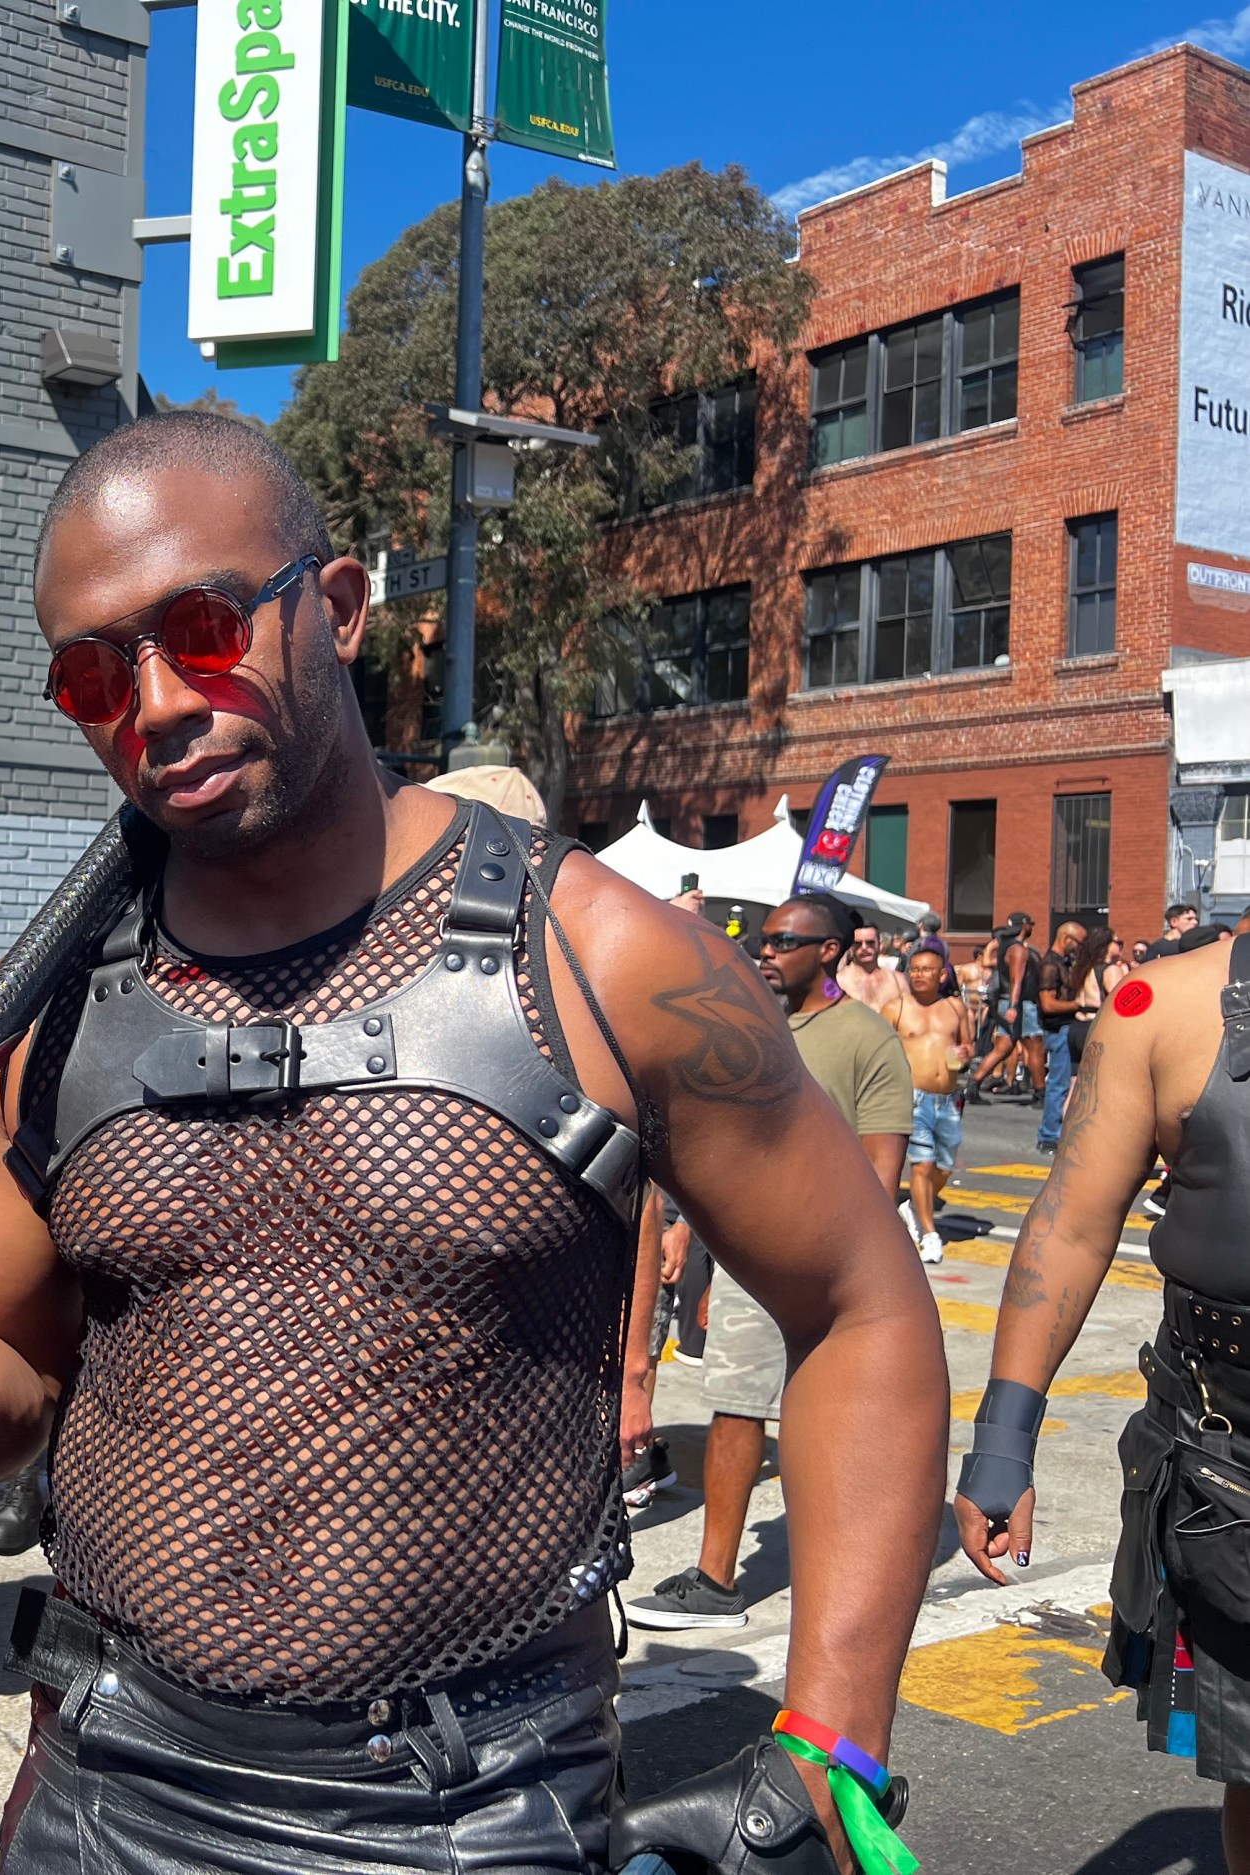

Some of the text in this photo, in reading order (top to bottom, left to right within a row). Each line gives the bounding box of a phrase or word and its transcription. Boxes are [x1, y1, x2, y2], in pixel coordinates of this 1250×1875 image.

[416, 0, 460, 28] CITY.
[534, 0, 598, 38] FRANCISCO
[503, 18, 530, 34] CHANGE
[531, 28, 543, 39] THE
[543, 33, 565, 47] WORLD
[565, 41, 583, 54] FROM
[374, 75, 430, 98] USFCA.EDU
[530, 114, 579, 137] USFCA.EDU
[1194, 385, 1248, 436] Futu
[410, 566, 430, 589] ST
